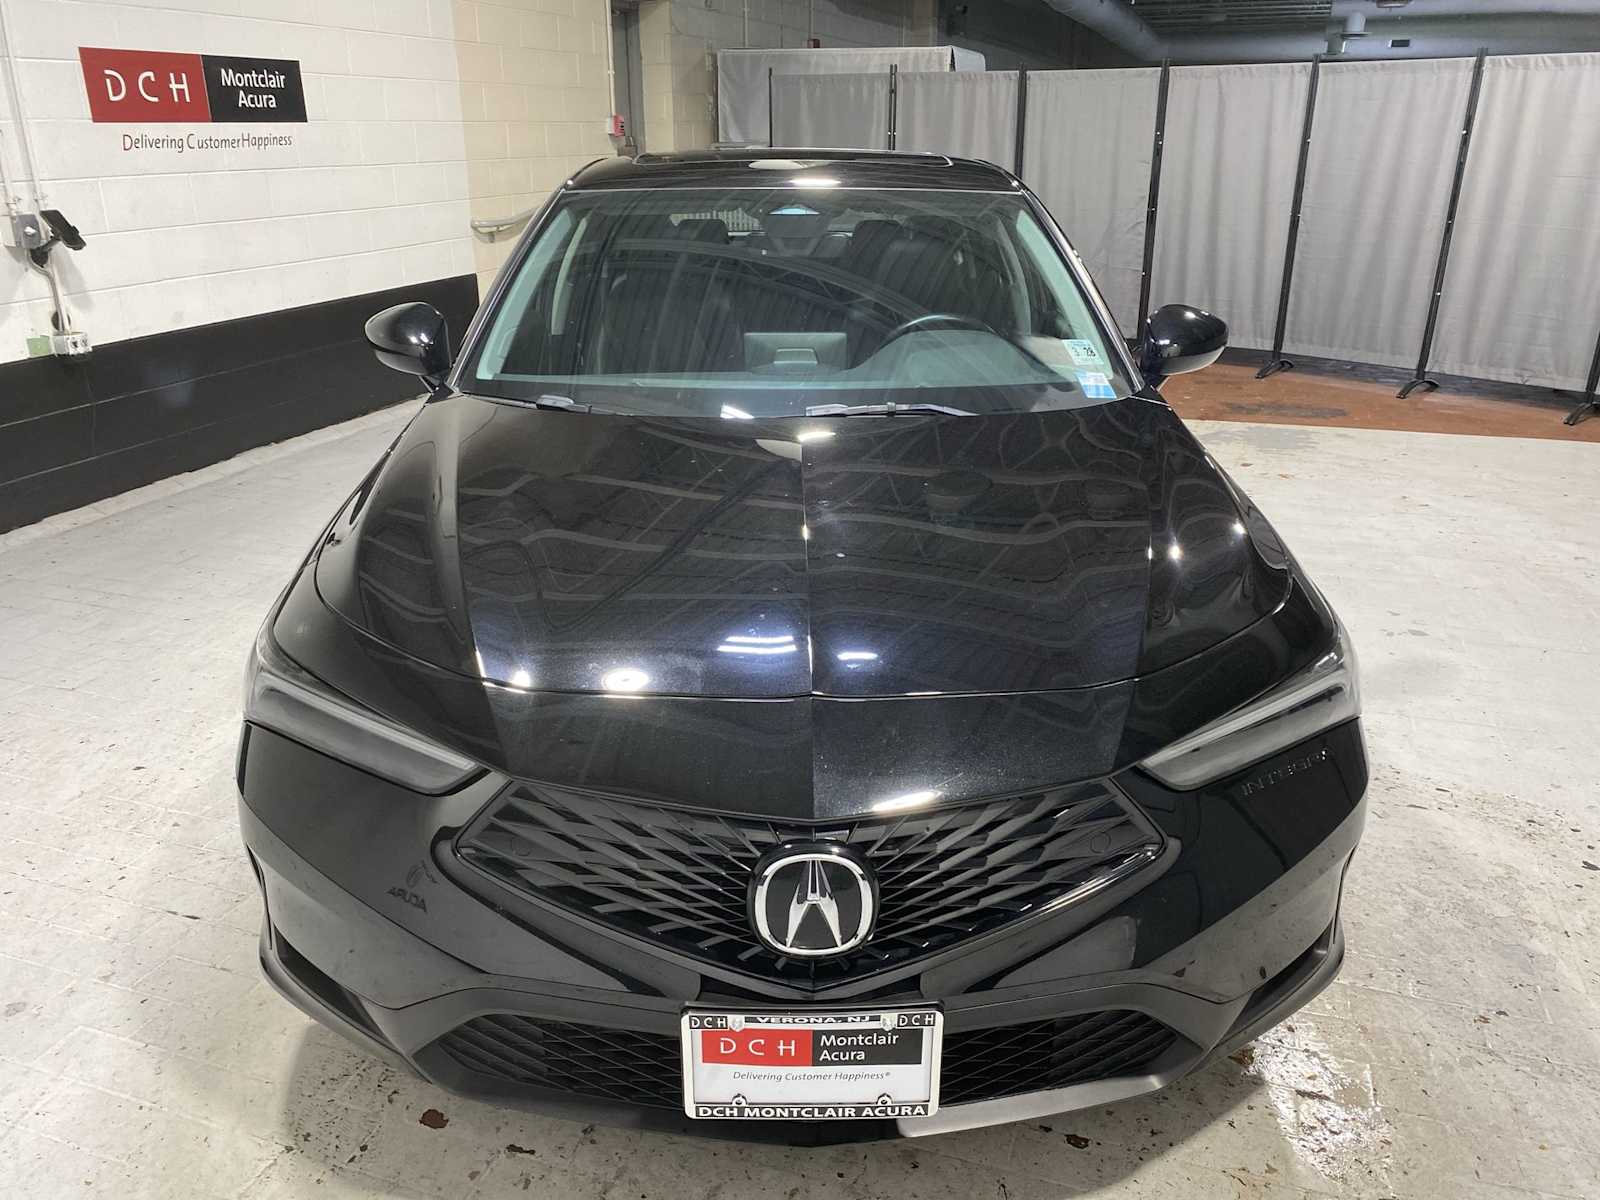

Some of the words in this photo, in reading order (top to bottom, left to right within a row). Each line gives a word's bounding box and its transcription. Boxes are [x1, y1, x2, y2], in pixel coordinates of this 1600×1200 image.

[220, 68, 286, 89] Montclair
[103, 69, 191, 103] DCH
[238, 90, 277, 109] Acura
[122, 134, 184, 153] Delivering
[186, 133, 240, 150] Customer
[241, 132, 293, 151] Happiness
[691, 1017, 726, 1028] DCH
[899, 1014, 934, 1026] DCH
[820, 1033, 899, 1046] Montclair
[720, 1037, 796, 1056] DCH
[820, 1049, 865, 1061] Acura
[733, 1071, 783, 1082] Delivering
[785, 1072, 832, 1081] Customer
[699, 1106, 738, 1118] DCH
[744, 1106, 856, 1118] MONTCLAIR
[864, 1105, 925, 1117] ACURA
